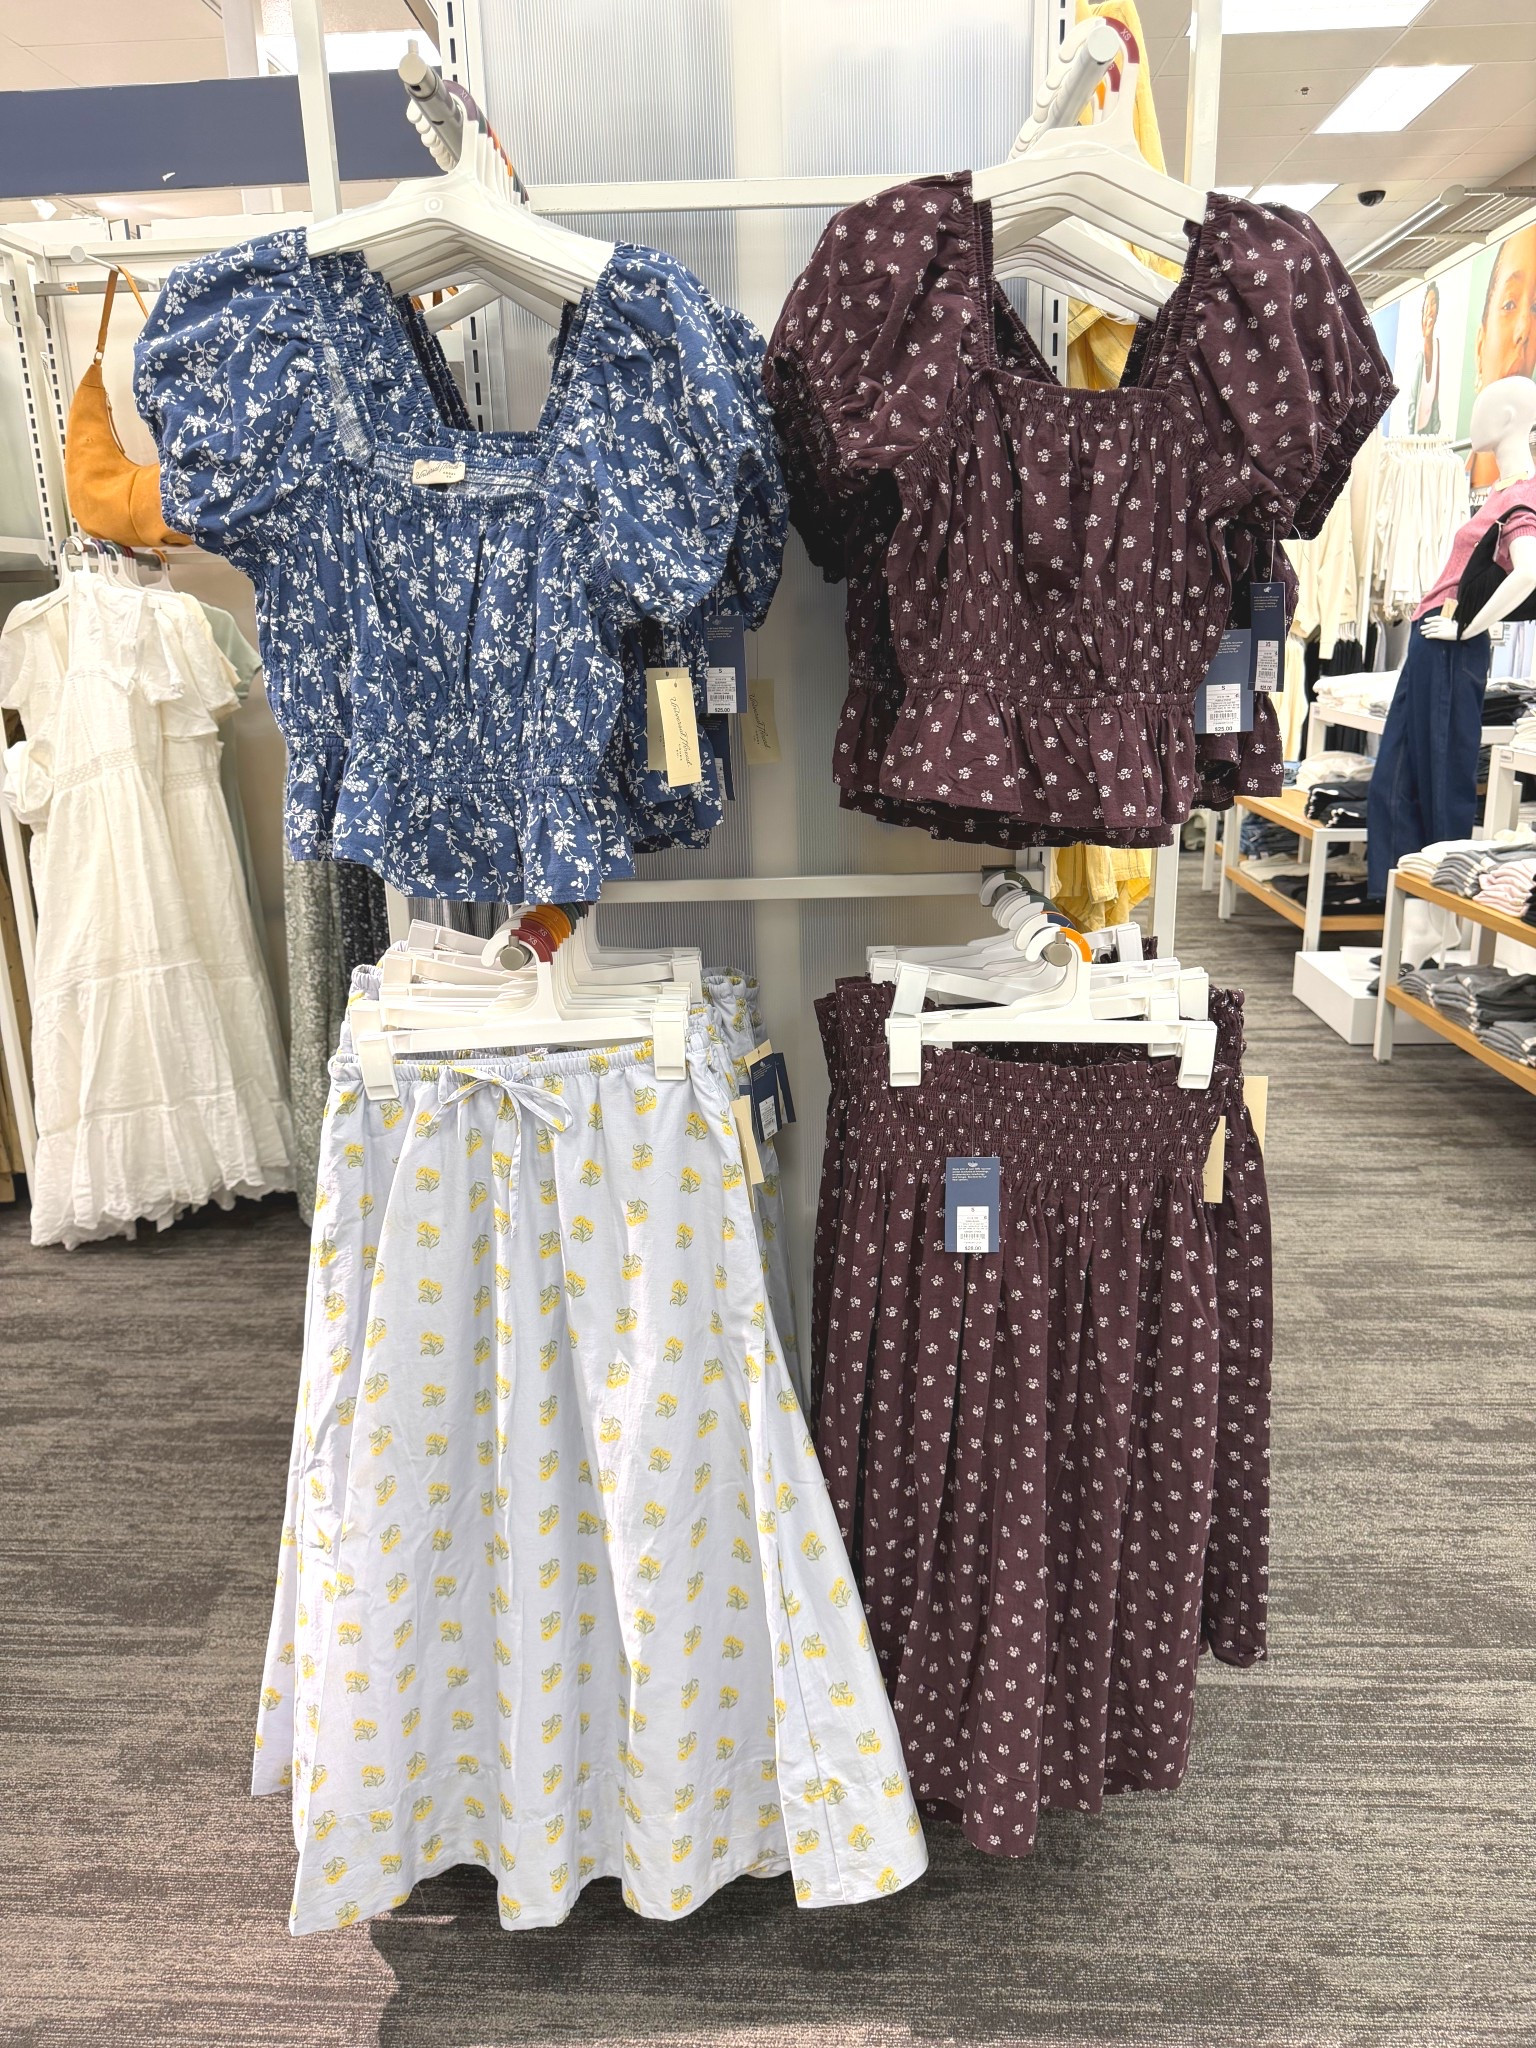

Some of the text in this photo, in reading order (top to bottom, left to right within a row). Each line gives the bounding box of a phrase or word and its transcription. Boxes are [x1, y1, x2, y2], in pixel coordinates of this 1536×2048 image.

[1120, 28, 1131, 41] XS
[669, 696, 688, 738] Universal
[528, 935, 537, 945] XS
